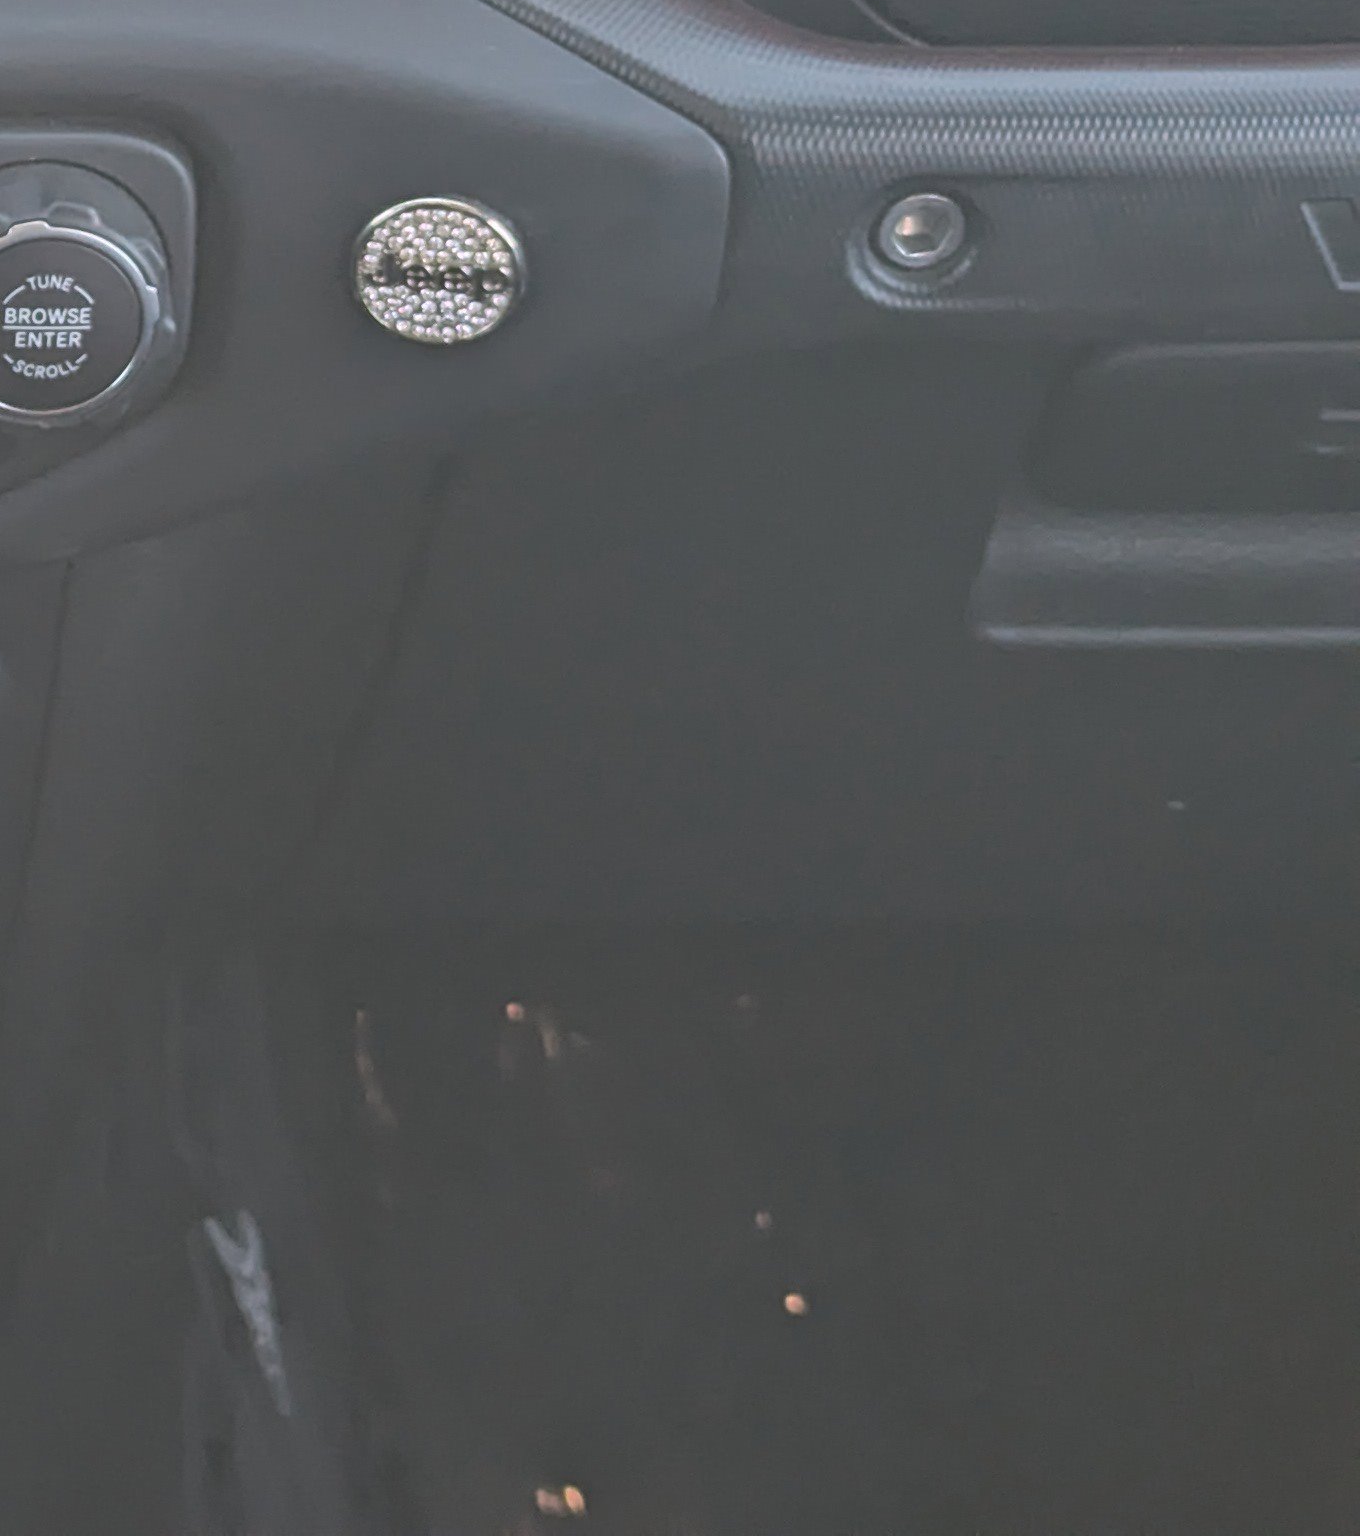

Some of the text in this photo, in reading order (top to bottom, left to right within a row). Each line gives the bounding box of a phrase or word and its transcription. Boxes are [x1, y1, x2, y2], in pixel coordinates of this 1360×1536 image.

[26, 275, 74, 292] TUNE
[4, 307, 91, 325] BROWSE
[15, 331, 81, 349] ENTER
[11, 359, 79, 380] SCROLL
